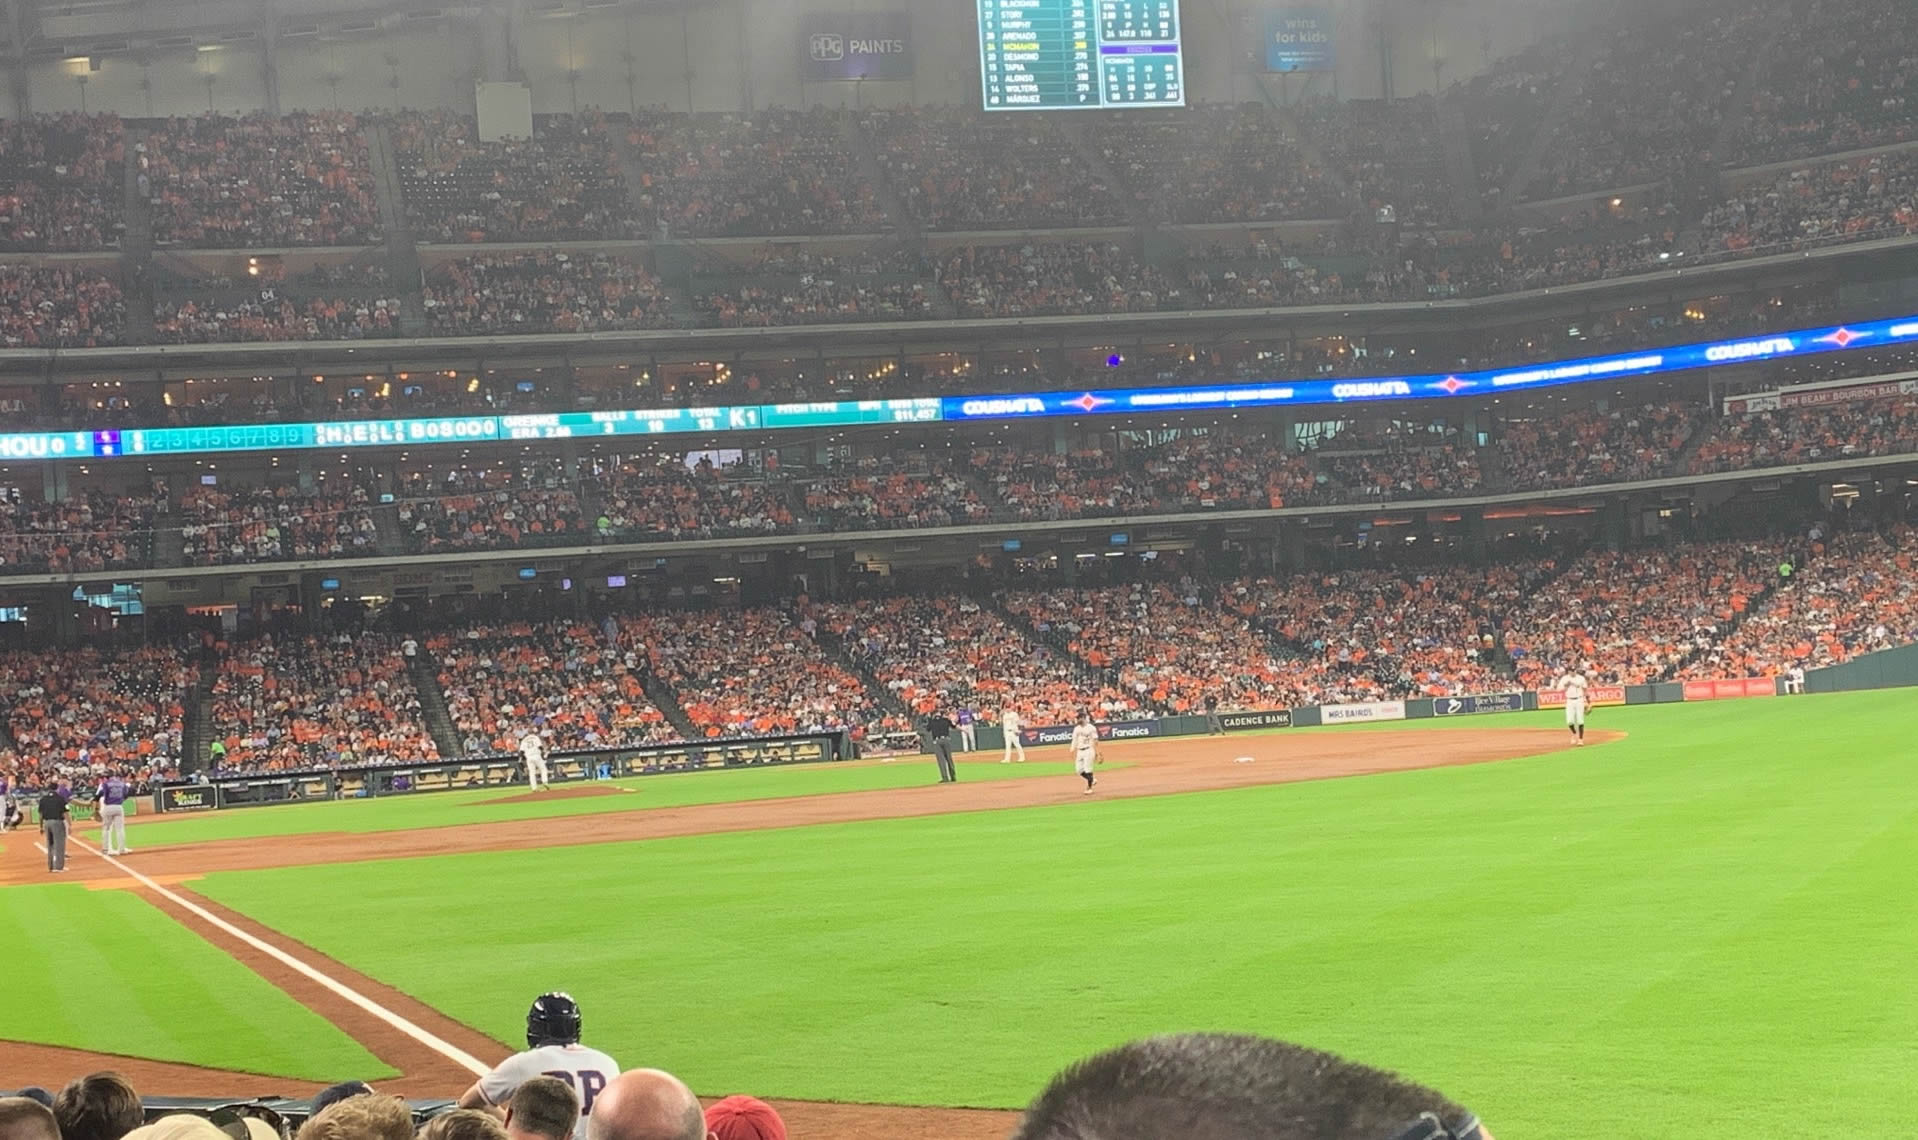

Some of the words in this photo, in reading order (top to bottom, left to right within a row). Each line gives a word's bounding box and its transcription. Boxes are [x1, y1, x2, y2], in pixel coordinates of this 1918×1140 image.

[1001, 10, 1023, 19] STORY
[1001, 20, 1032, 29] MURPHY
[1286, 18, 1317, 29] wins
[1002, 32, 1037, 41] ARENADO
[1275, 31, 1296, 43] for
[1299, 31, 1327, 43] kids
[812, 37, 841, 57] PPG
[850, 40, 903, 54] PAINTS
[1004, 52, 1039, 61] DESMOND
[1004, 63, 1026, 72] TAPIA
[1005, 74, 1035, 83] ALONSO
[991, 85, 1001, 94] 14
[1006, 84, 1039, 93] WOLTERS
[1081, 94, 1088, 103] P
[1706, 337, 1794, 361] COUSHATTA
[1331, 380, 1410, 399] COUSHATTA
[1783, 396, 1799, 406] JIM
[1801, 394, 1826, 405] BEAM
[1833, 388, 1876, 401] BOURBON
[1879, 386, 1898, 396] BAR
[689, 407, 722, 417] TOTAL
[963, 397, 1045, 416] COUSHATTA
[592, 411, 627, 422] BALLS
[635, 409, 681, 420] STRIKES
[211, 432, 221, 444] 5
[230, 430, 240, 443] 6
[250, 430, 259, 442] 7
[270, 429, 280, 442] 8
[289, 428, 298, 441] 9
[327, 426, 342, 442] H
[353, 424, 367, 441] E
[380, 424, 392, 440] L
[511, 427, 540, 439] ERA
[152, 435, 163, 448] 2
[172, 434, 182, 446] 3
[191, 432, 201, 445] 4
[1539, 692, 1566, 704] WEL
[1590, 688, 1623, 702] ARGO
[1328, 709, 1344, 719] MRS
[1224, 715, 1263, 727] CADENCE
[1265, 714, 1289, 725] BANK
[1039, 731, 1073, 743] Fanatic
[1111, 726, 1149, 740] Fanatics
